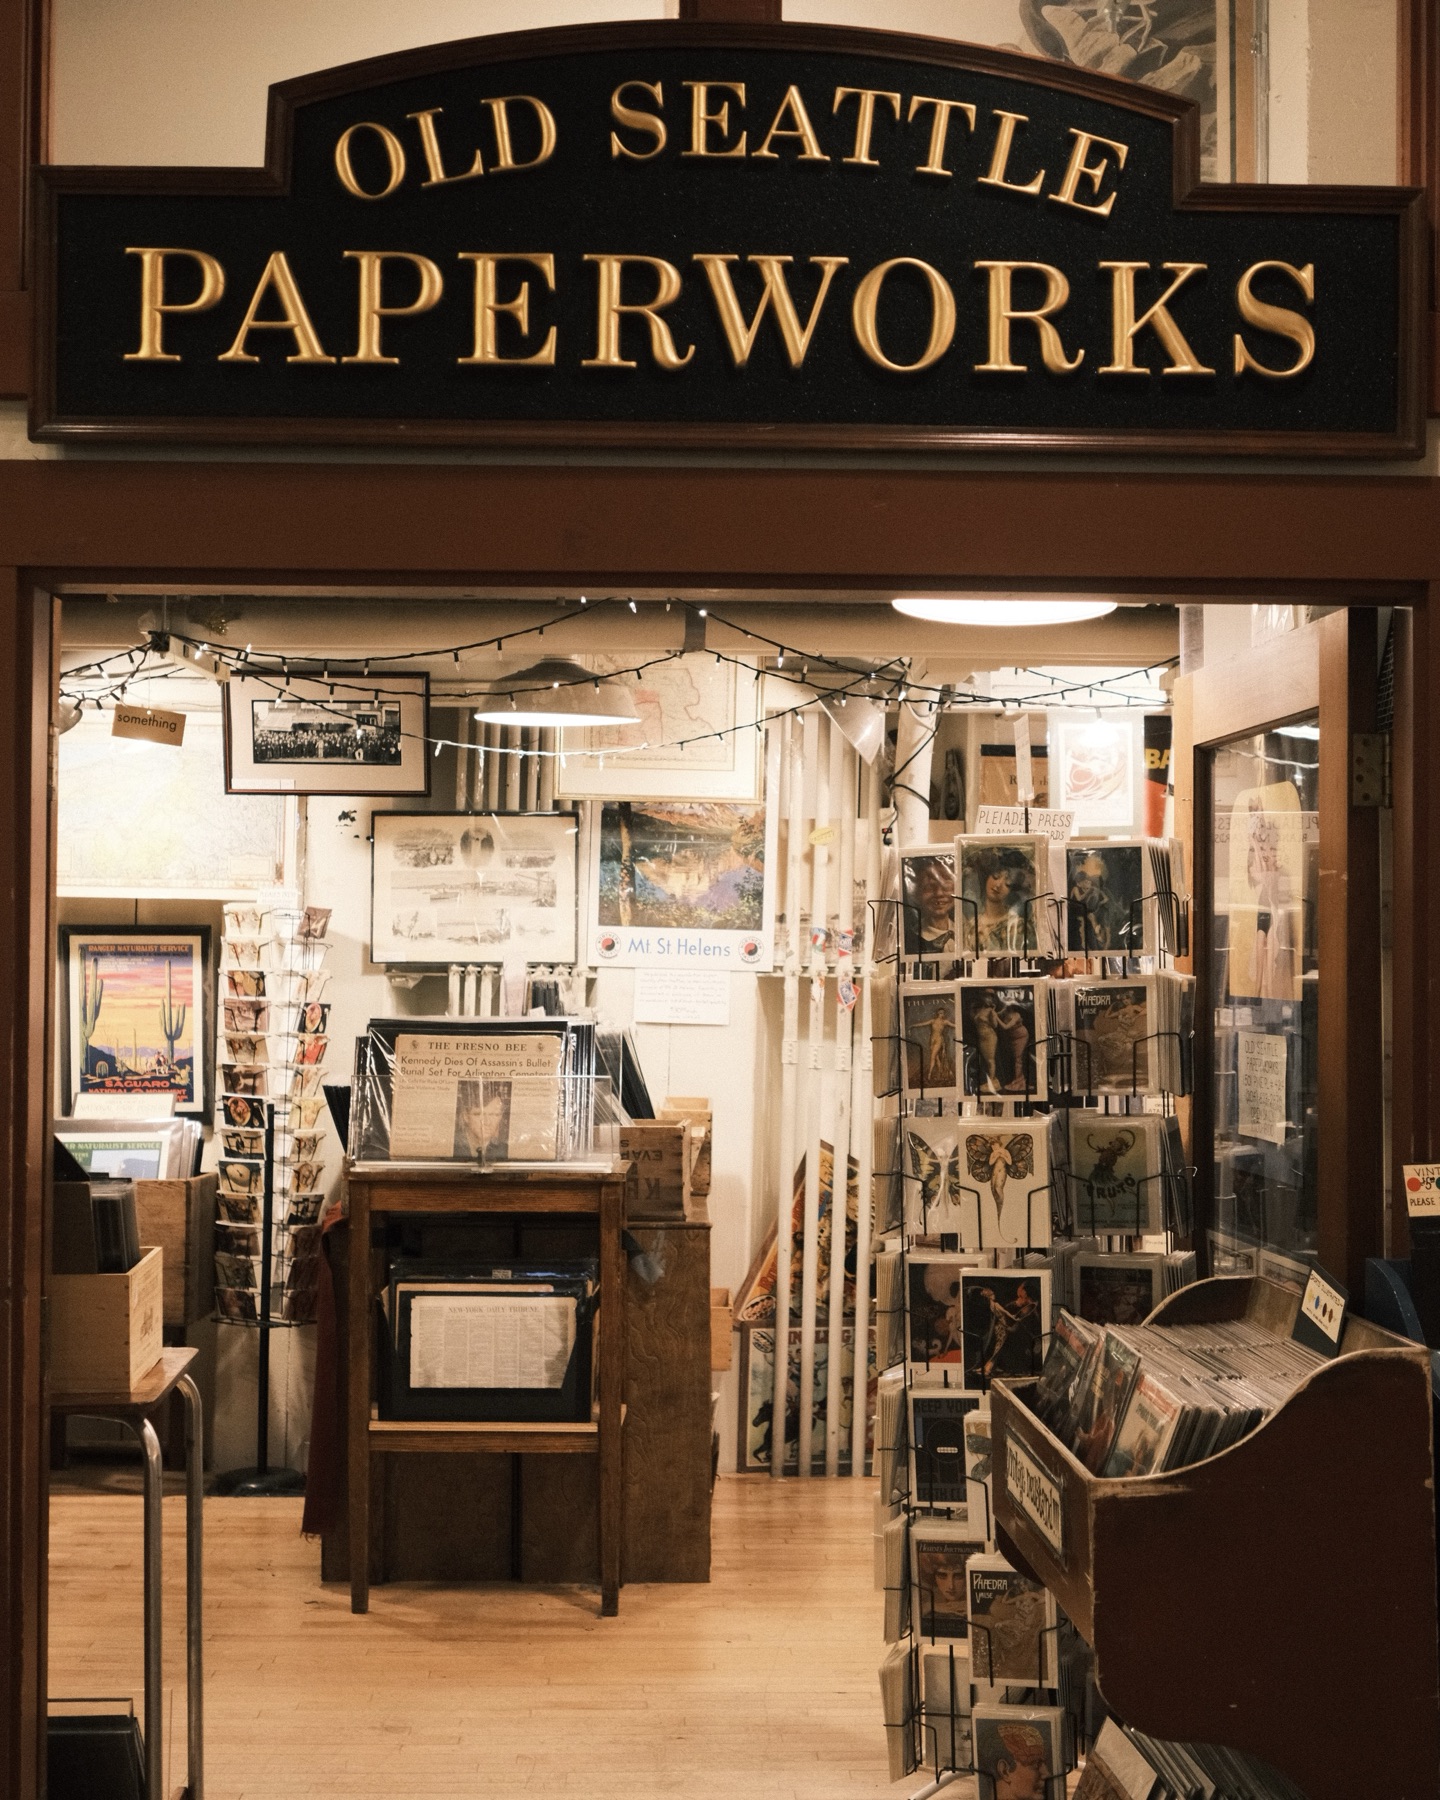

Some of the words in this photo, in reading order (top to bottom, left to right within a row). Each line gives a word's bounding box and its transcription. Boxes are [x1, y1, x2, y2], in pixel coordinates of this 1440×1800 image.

[335, 94, 558, 200] OLD
[610, 80, 1129, 217] SEATTLE
[123, 246, 1316, 378] PAPERWORKS
[117, 714, 178, 733] something
[1037, 813, 1072, 828] PRESS
[88, 944, 116, 952] RANGER
[117, 944, 159, 952] NATURALIST
[159, 944, 189, 952] SERVICE
[628, 937, 653, 953] Mt.
[657, 937, 673, 955] St.
[677, 938, 731, 957] Helens
[428, 1041, 451, 1051] THE
[455, 1042, 500, 1052] FRESNO
[505, 1043, 527, 1052] BEE
[401, 1056, 441, 1066] Kennedy
[444, 1057, 464, 1066] Dies
[466, 1058, 478, 1066] Of
[480, 1058, 523, 1067] Assassin's
[400, 1067, 426, 1076] Burial
[428, 1068, 444, 1076] Set
[447, 1068, 462, 1077] For
[104, 1080, 170, 1088] SAGUARO
[1410, 1197, 1436, 1207] PLEASE
